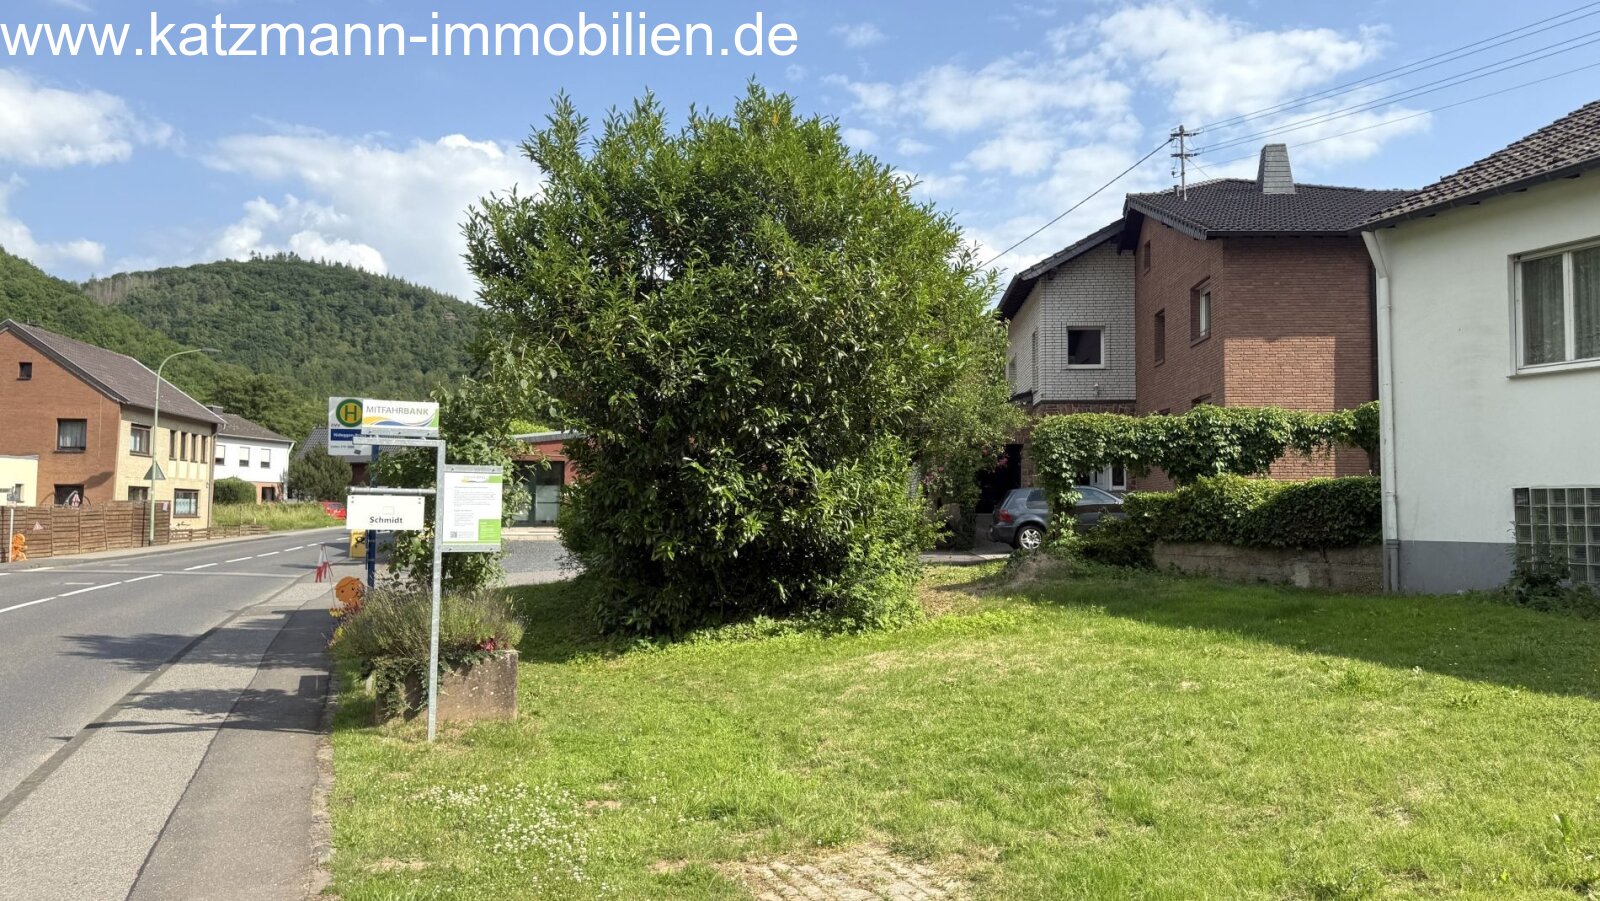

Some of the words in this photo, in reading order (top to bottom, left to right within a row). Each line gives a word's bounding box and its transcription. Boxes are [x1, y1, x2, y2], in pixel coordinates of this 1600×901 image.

[345, 405, 357, 421] H
[366, 405, 429, 416] MITFAHRBANK
[369, 516, 403, 525] Schmidt
